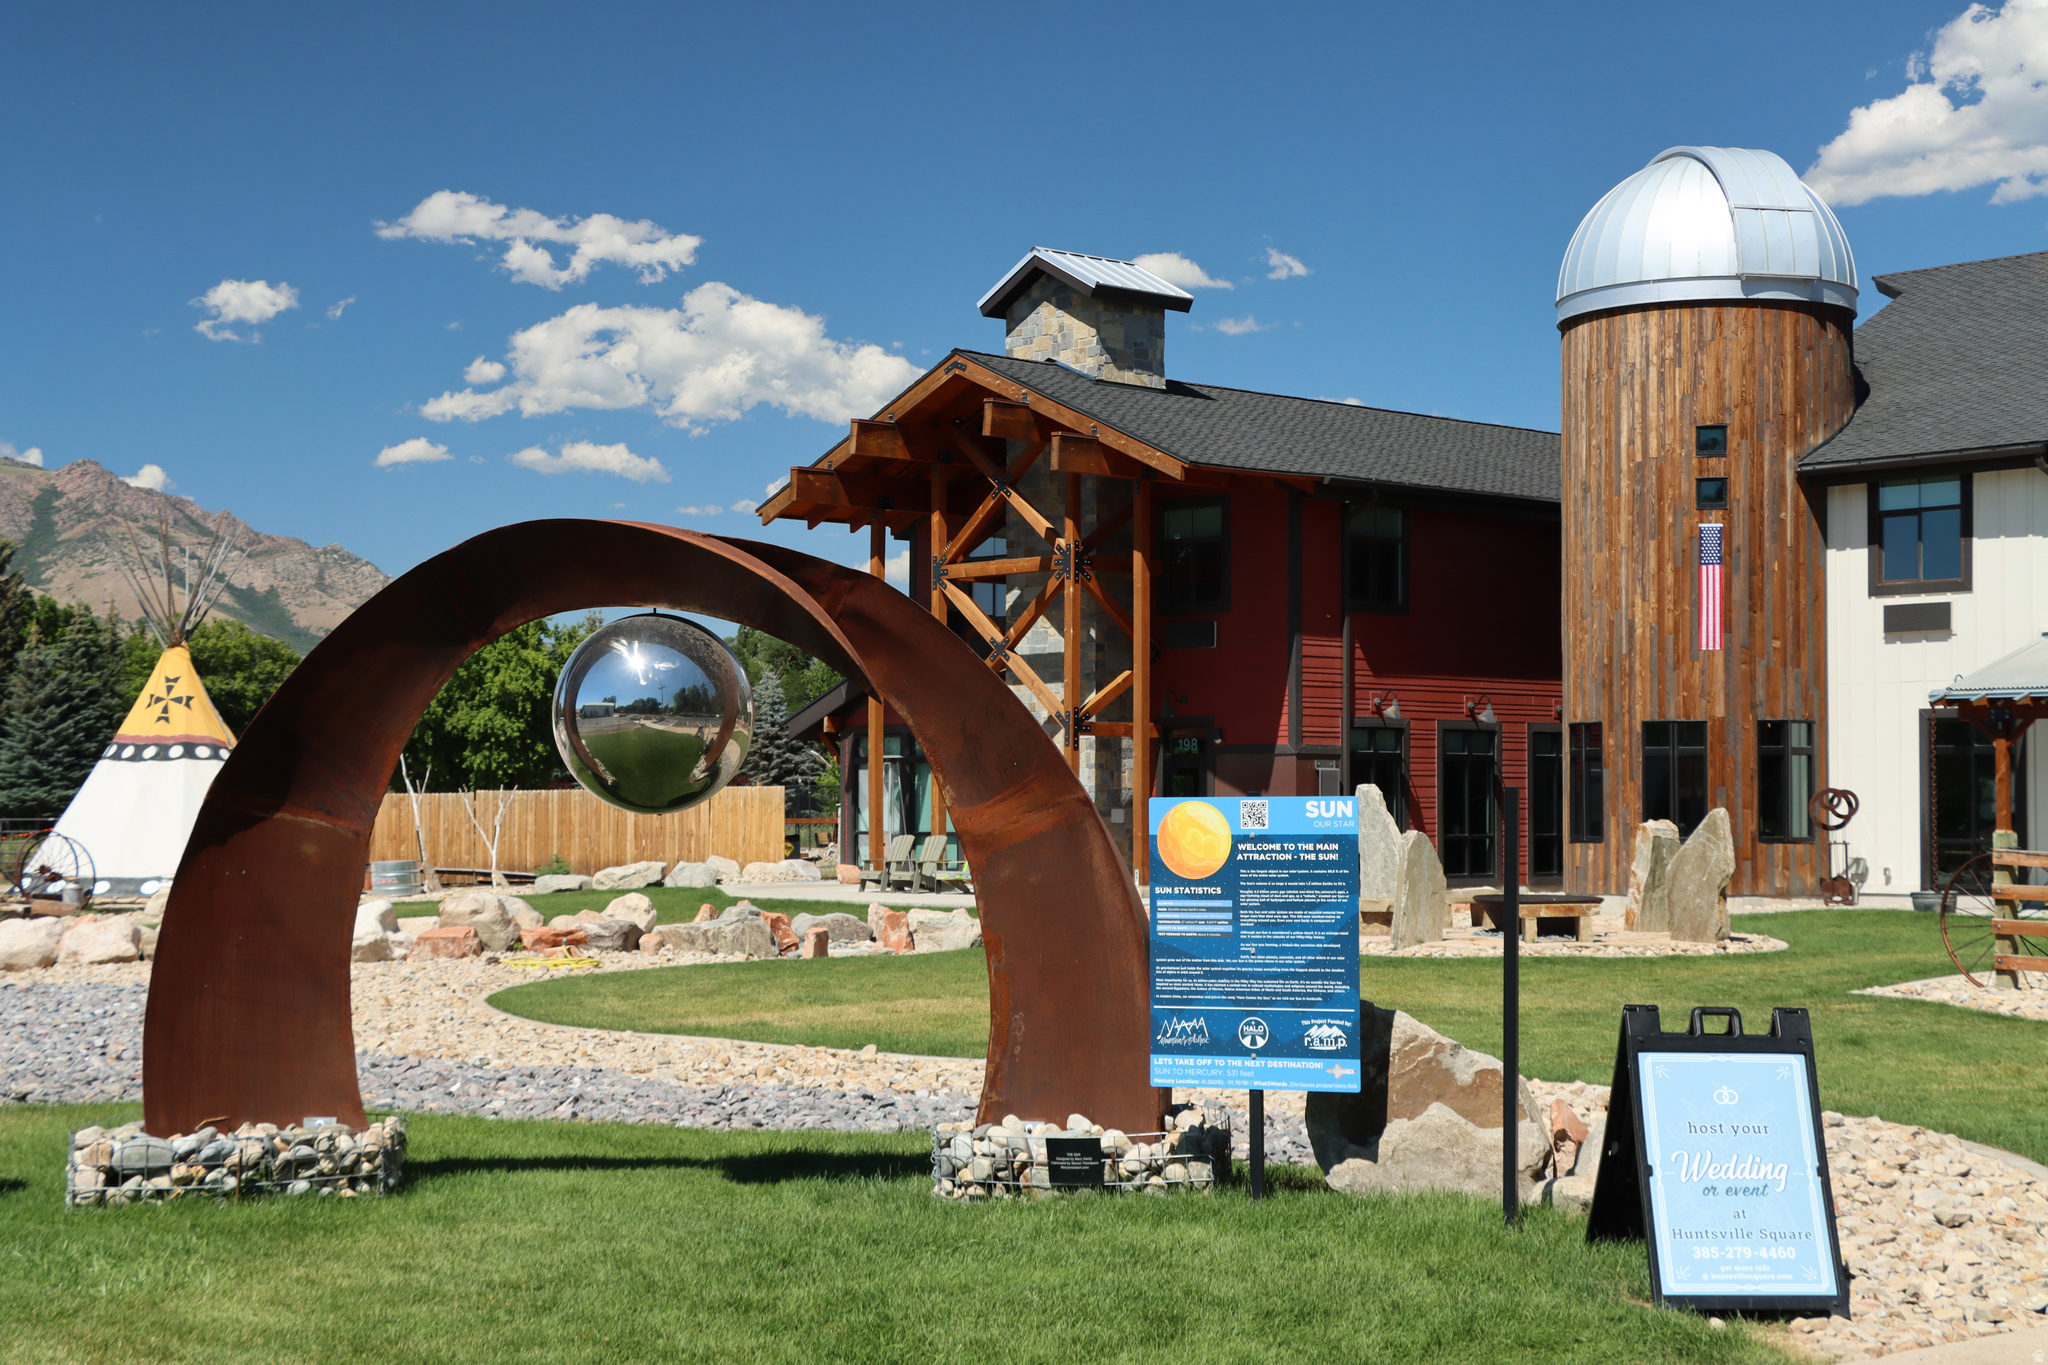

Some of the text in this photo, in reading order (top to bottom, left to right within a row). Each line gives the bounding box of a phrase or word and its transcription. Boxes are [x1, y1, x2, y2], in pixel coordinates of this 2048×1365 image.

[1178, 738, 1198, 751] 198
[1305, 800, 1353, 818] SUN
[1688, 1122, 1770, 1137] host your
[1671, 1150, 1789, 1192] Wedding
[1703, 1183, 1769, 1197] or event
[1733, 1208, 1747, 1219] at
[1672, 1228, 1812, 1242] Huntsville Square
[1692, 1246, 1796, 1259] 385-279-4460
